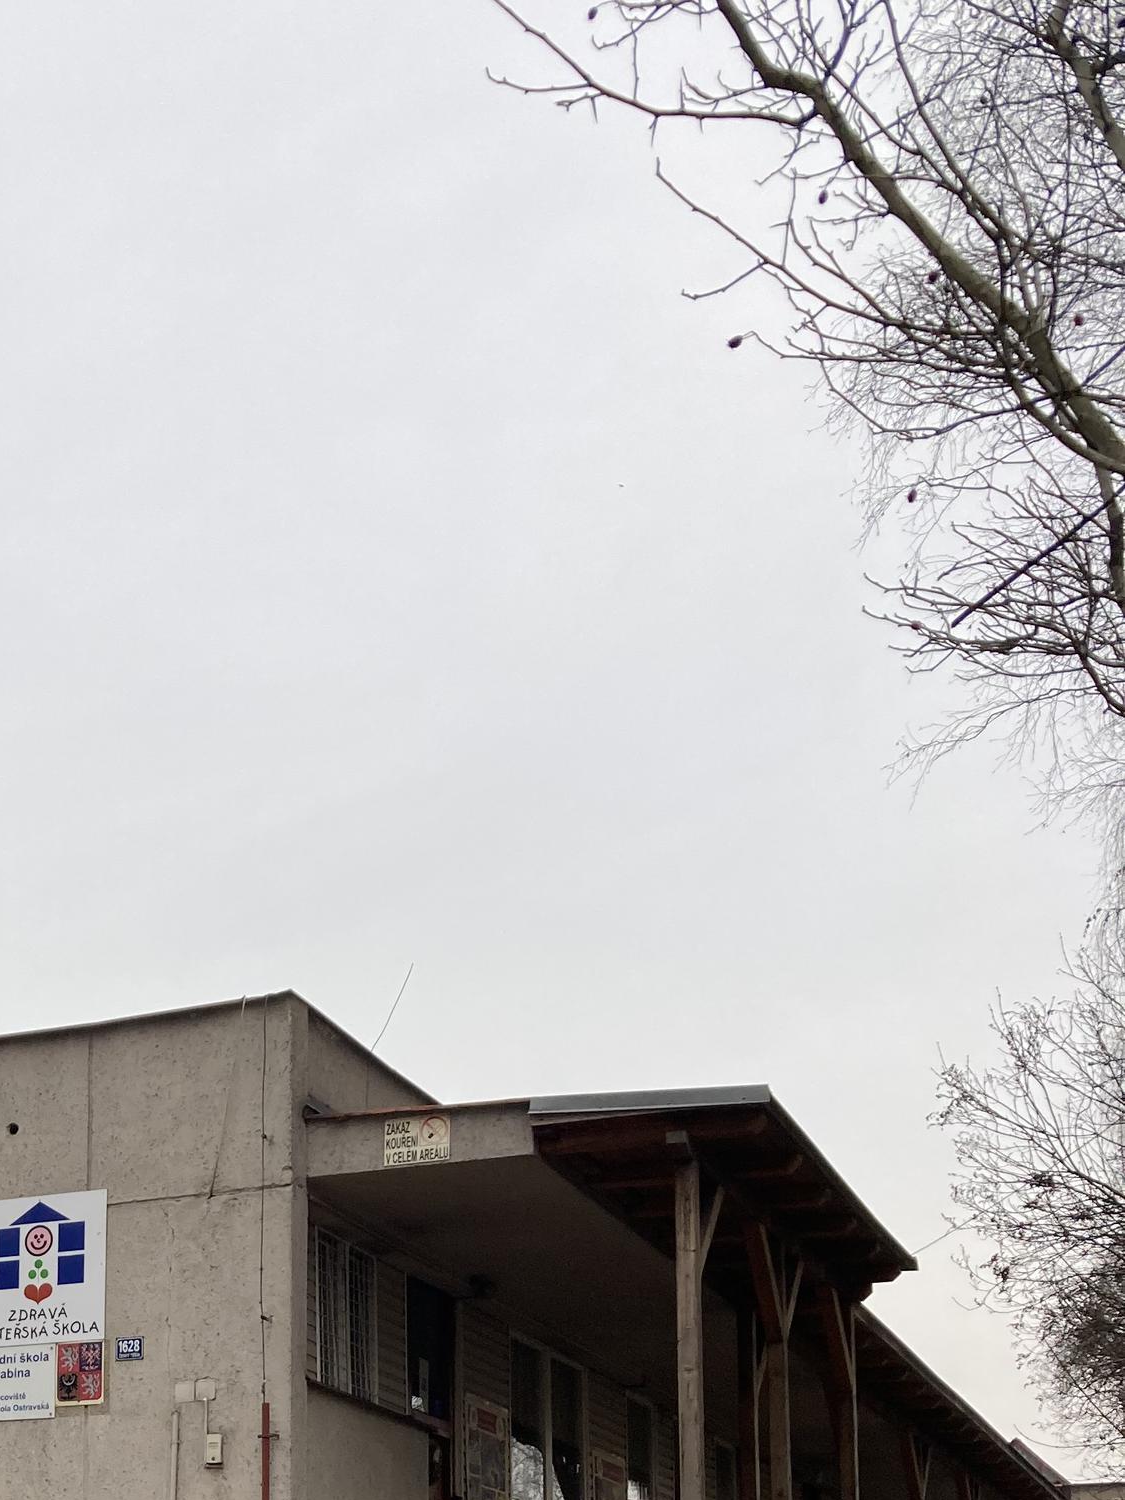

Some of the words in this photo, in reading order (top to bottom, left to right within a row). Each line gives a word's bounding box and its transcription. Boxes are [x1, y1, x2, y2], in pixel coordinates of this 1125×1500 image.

[386, 1153, 391, 1164] V
[8, 1303, 67, 1321] ZDRAVÁ
[52, 1319, 99, 1336] ŠKOLA
[119, 1340, 140, 1352] 1628
[20, 1352, 49, 1363] škola
[13, 1402, 49, 1411] Ostravská
